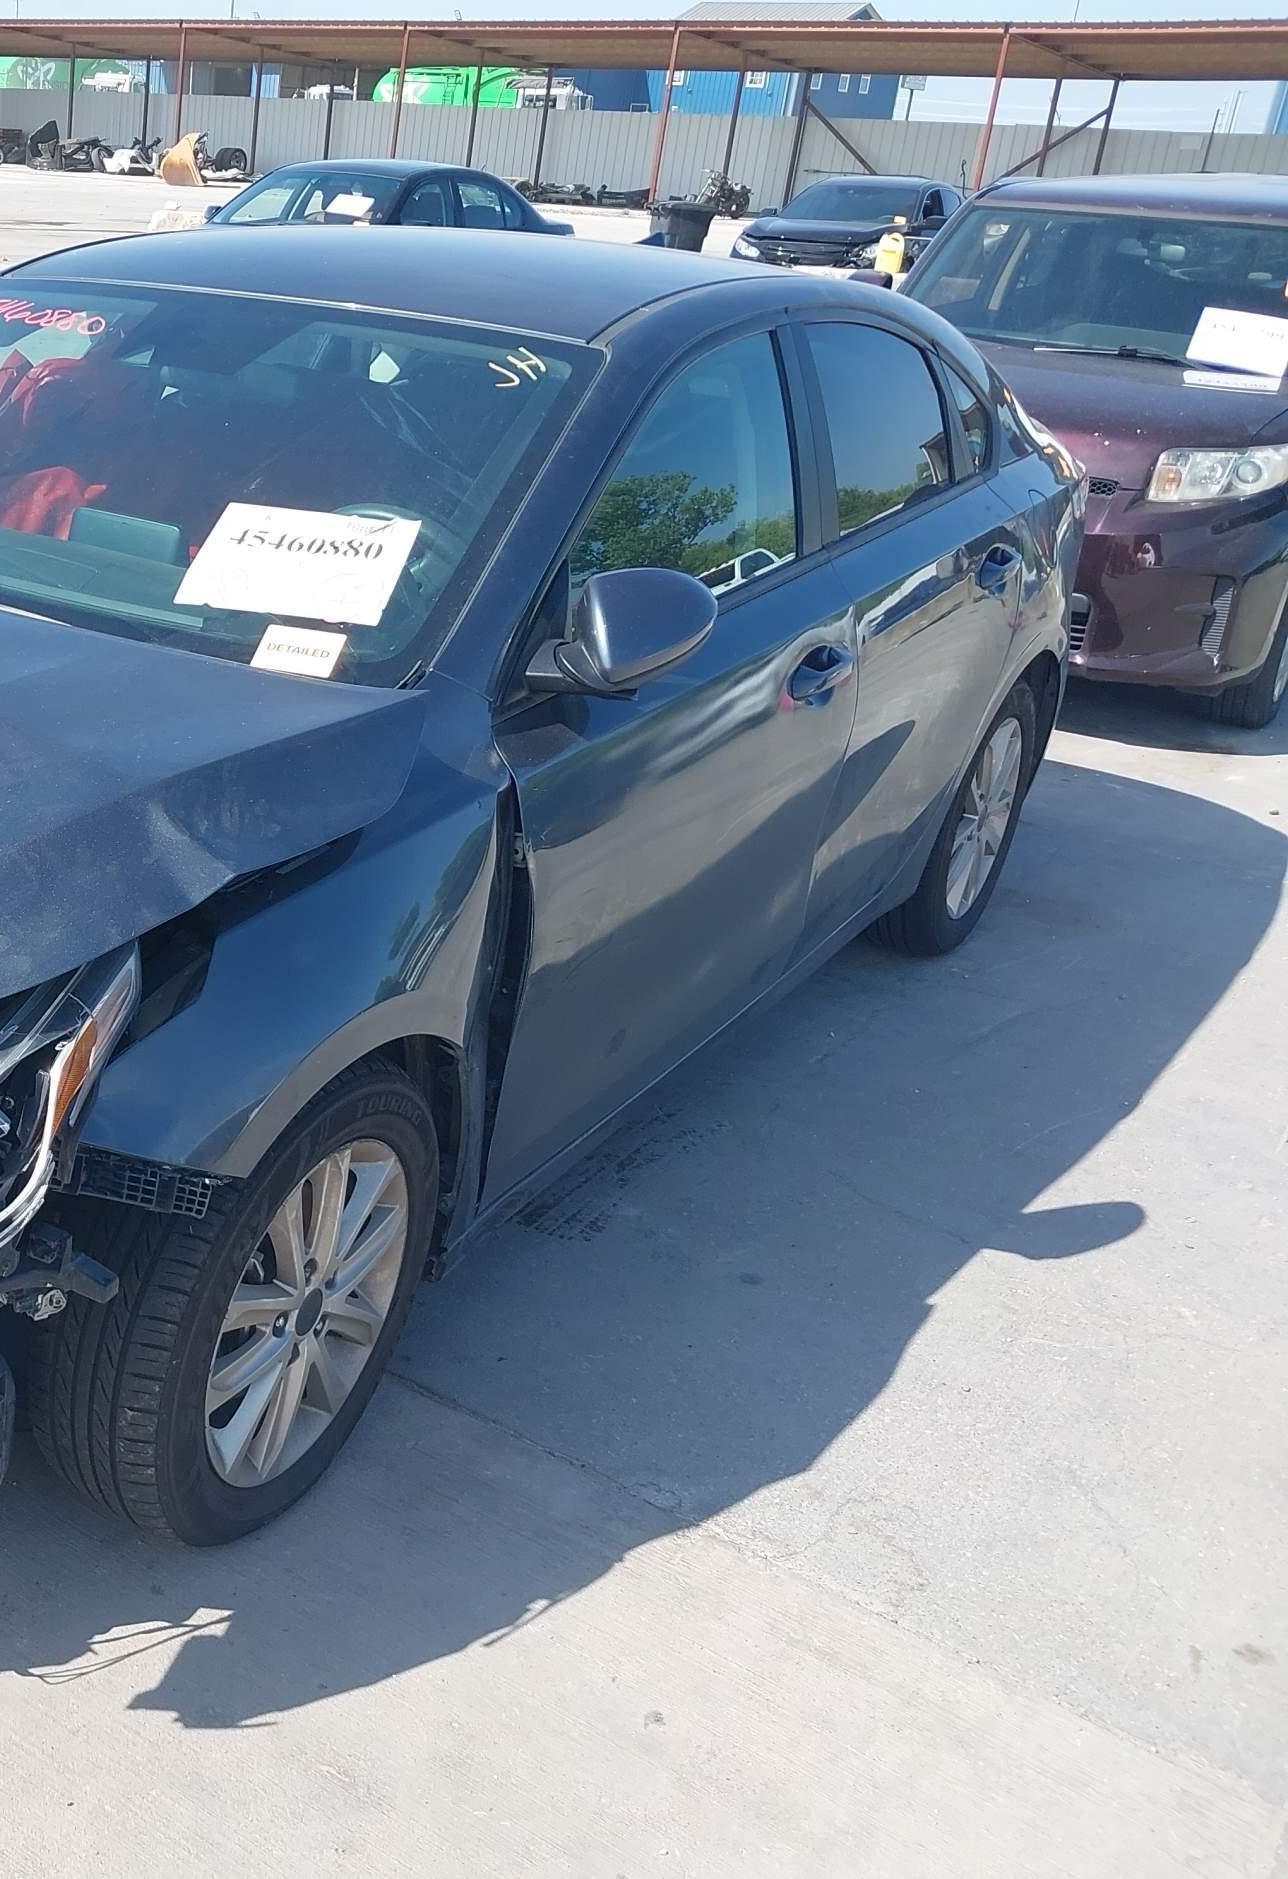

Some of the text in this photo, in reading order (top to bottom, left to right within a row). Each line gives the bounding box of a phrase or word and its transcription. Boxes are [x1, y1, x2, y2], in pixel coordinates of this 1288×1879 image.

[230, 528, 383, 559] 45460880
[266, 642, 330, 658] DETAILED
[357, 1094, 423, 1126] TOURING
